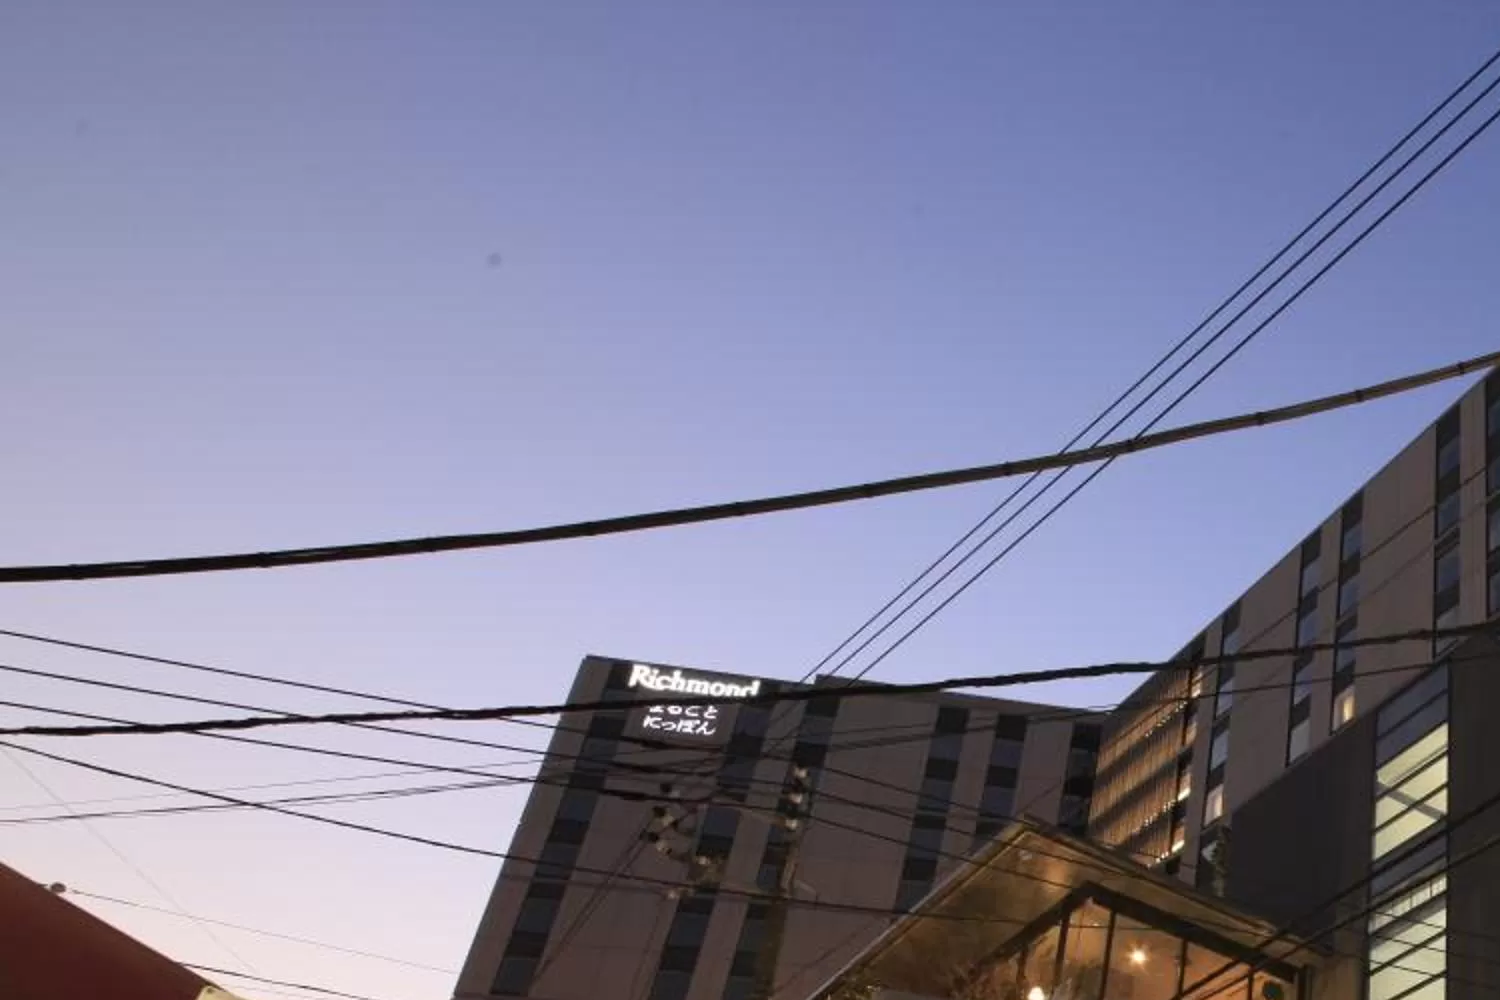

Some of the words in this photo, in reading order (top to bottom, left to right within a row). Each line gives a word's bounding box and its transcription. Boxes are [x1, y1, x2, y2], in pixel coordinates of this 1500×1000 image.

[628, 664, 760, 697] Richmond
[643, 715, 716, 735] にっぽん
